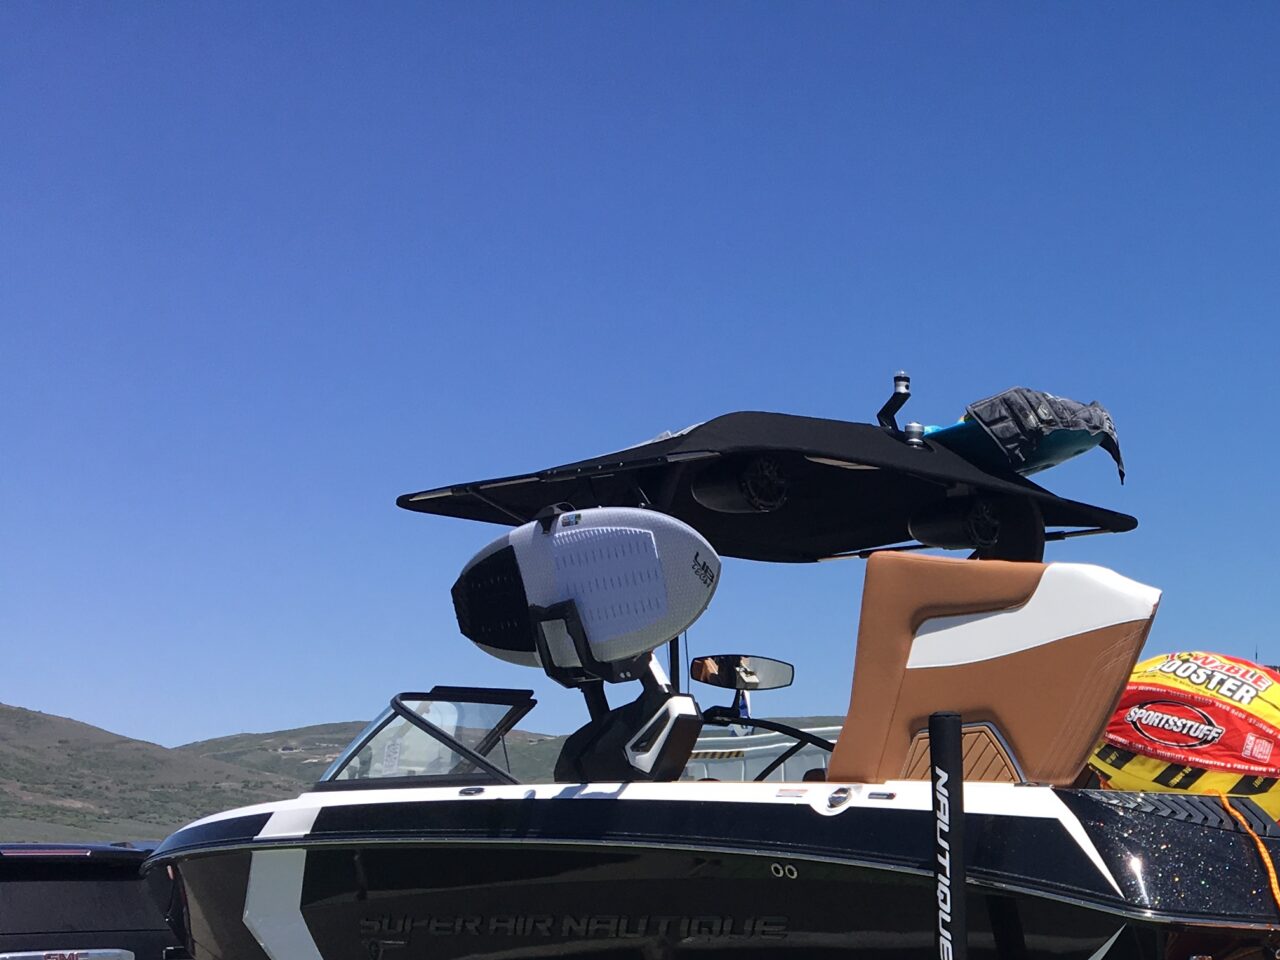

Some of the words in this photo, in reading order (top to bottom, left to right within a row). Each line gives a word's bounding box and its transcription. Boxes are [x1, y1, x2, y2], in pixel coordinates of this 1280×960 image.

[1124, 706, 1225, 744] SPORTSSTUFF
[360, 914, 483, 936] SUPER
[489, 914, 554, 937] AIR
[560, 914, 789, 940] NAUTIQUE
